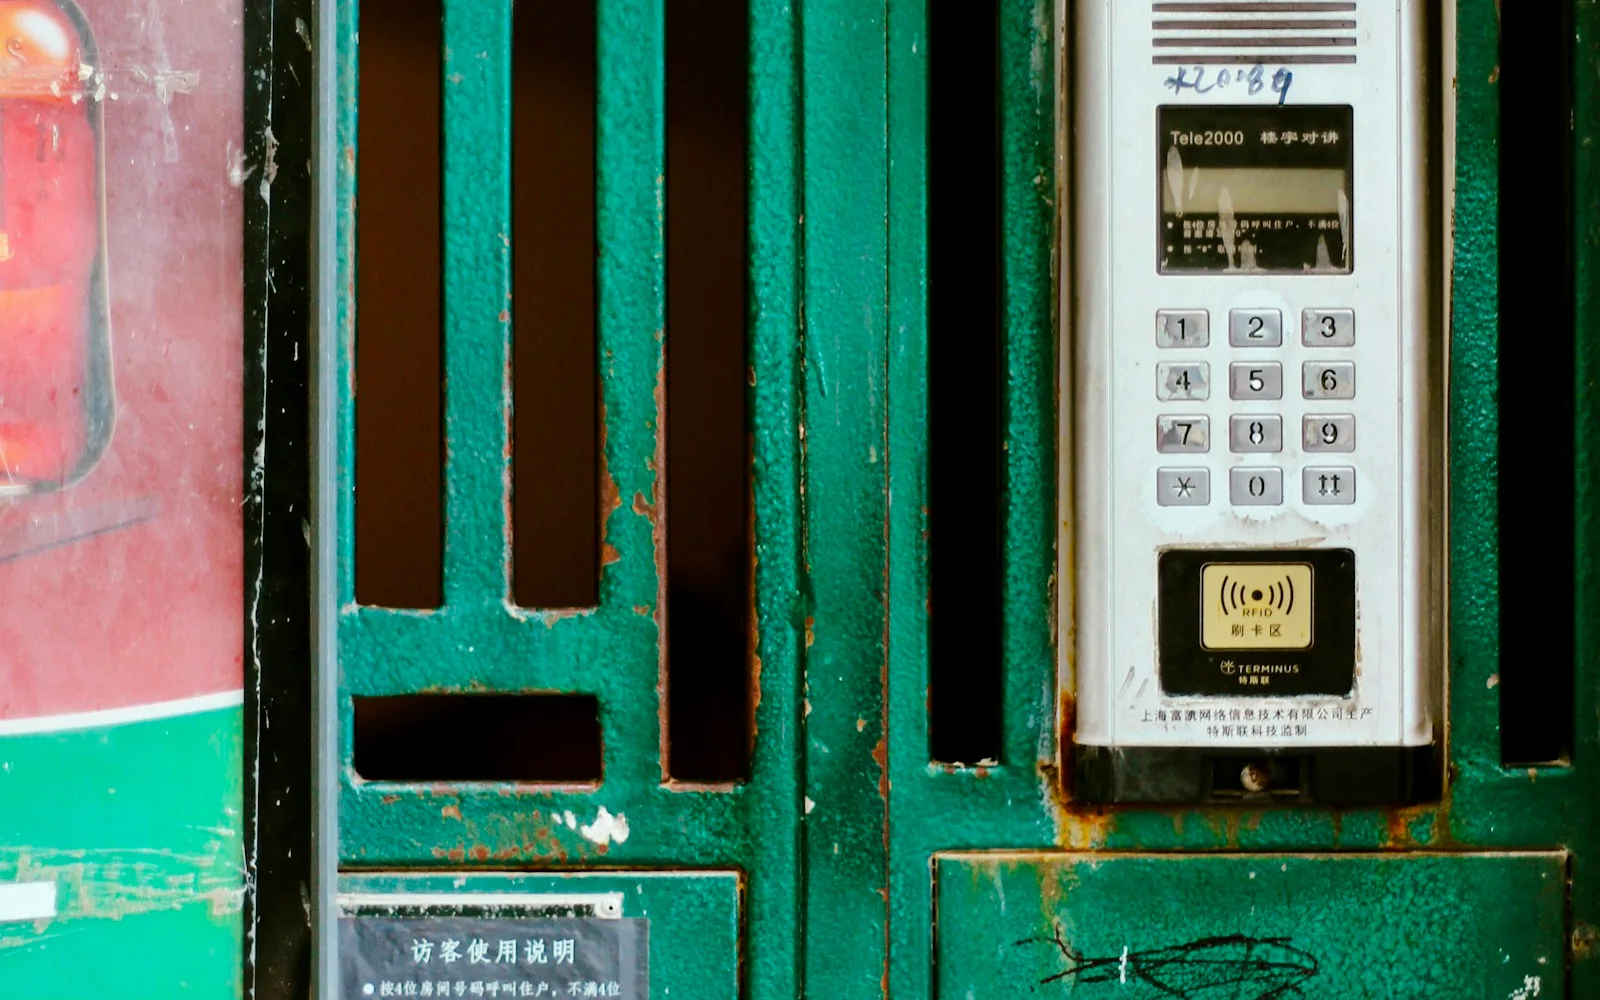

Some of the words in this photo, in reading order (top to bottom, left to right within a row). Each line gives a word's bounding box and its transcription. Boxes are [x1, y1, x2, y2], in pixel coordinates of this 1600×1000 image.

[1170, 130, 1244, 145] Tele2000
[1260, 130, 1340, 145] 楼宇对讲
[1177, 318, 1186, 340] 1
[1248, 316, 1264, 338] 2
[1320, 316, 1336, 338] 3
[1176, 370, 1191, 391] 4
[1249, 369, 1264, 392] 5
[1320, 368, 1337, 391] 6
[1176, 423, 1192, 445] 7
[1249, 421, 1264, 446] 8
[1321, 422, 1338, 445] 9
[1248, 475, 1265, 498] 0
[1242, 607, 1273, 617] RFID
[1231, 623, 1282, 637] 刷卡区
[1238, 664, 1299, 674] TERMINUS
[1206, 724, 1308, 738] 特斯联科技监制
[411, 938, 575, 965] 访客使用说明
